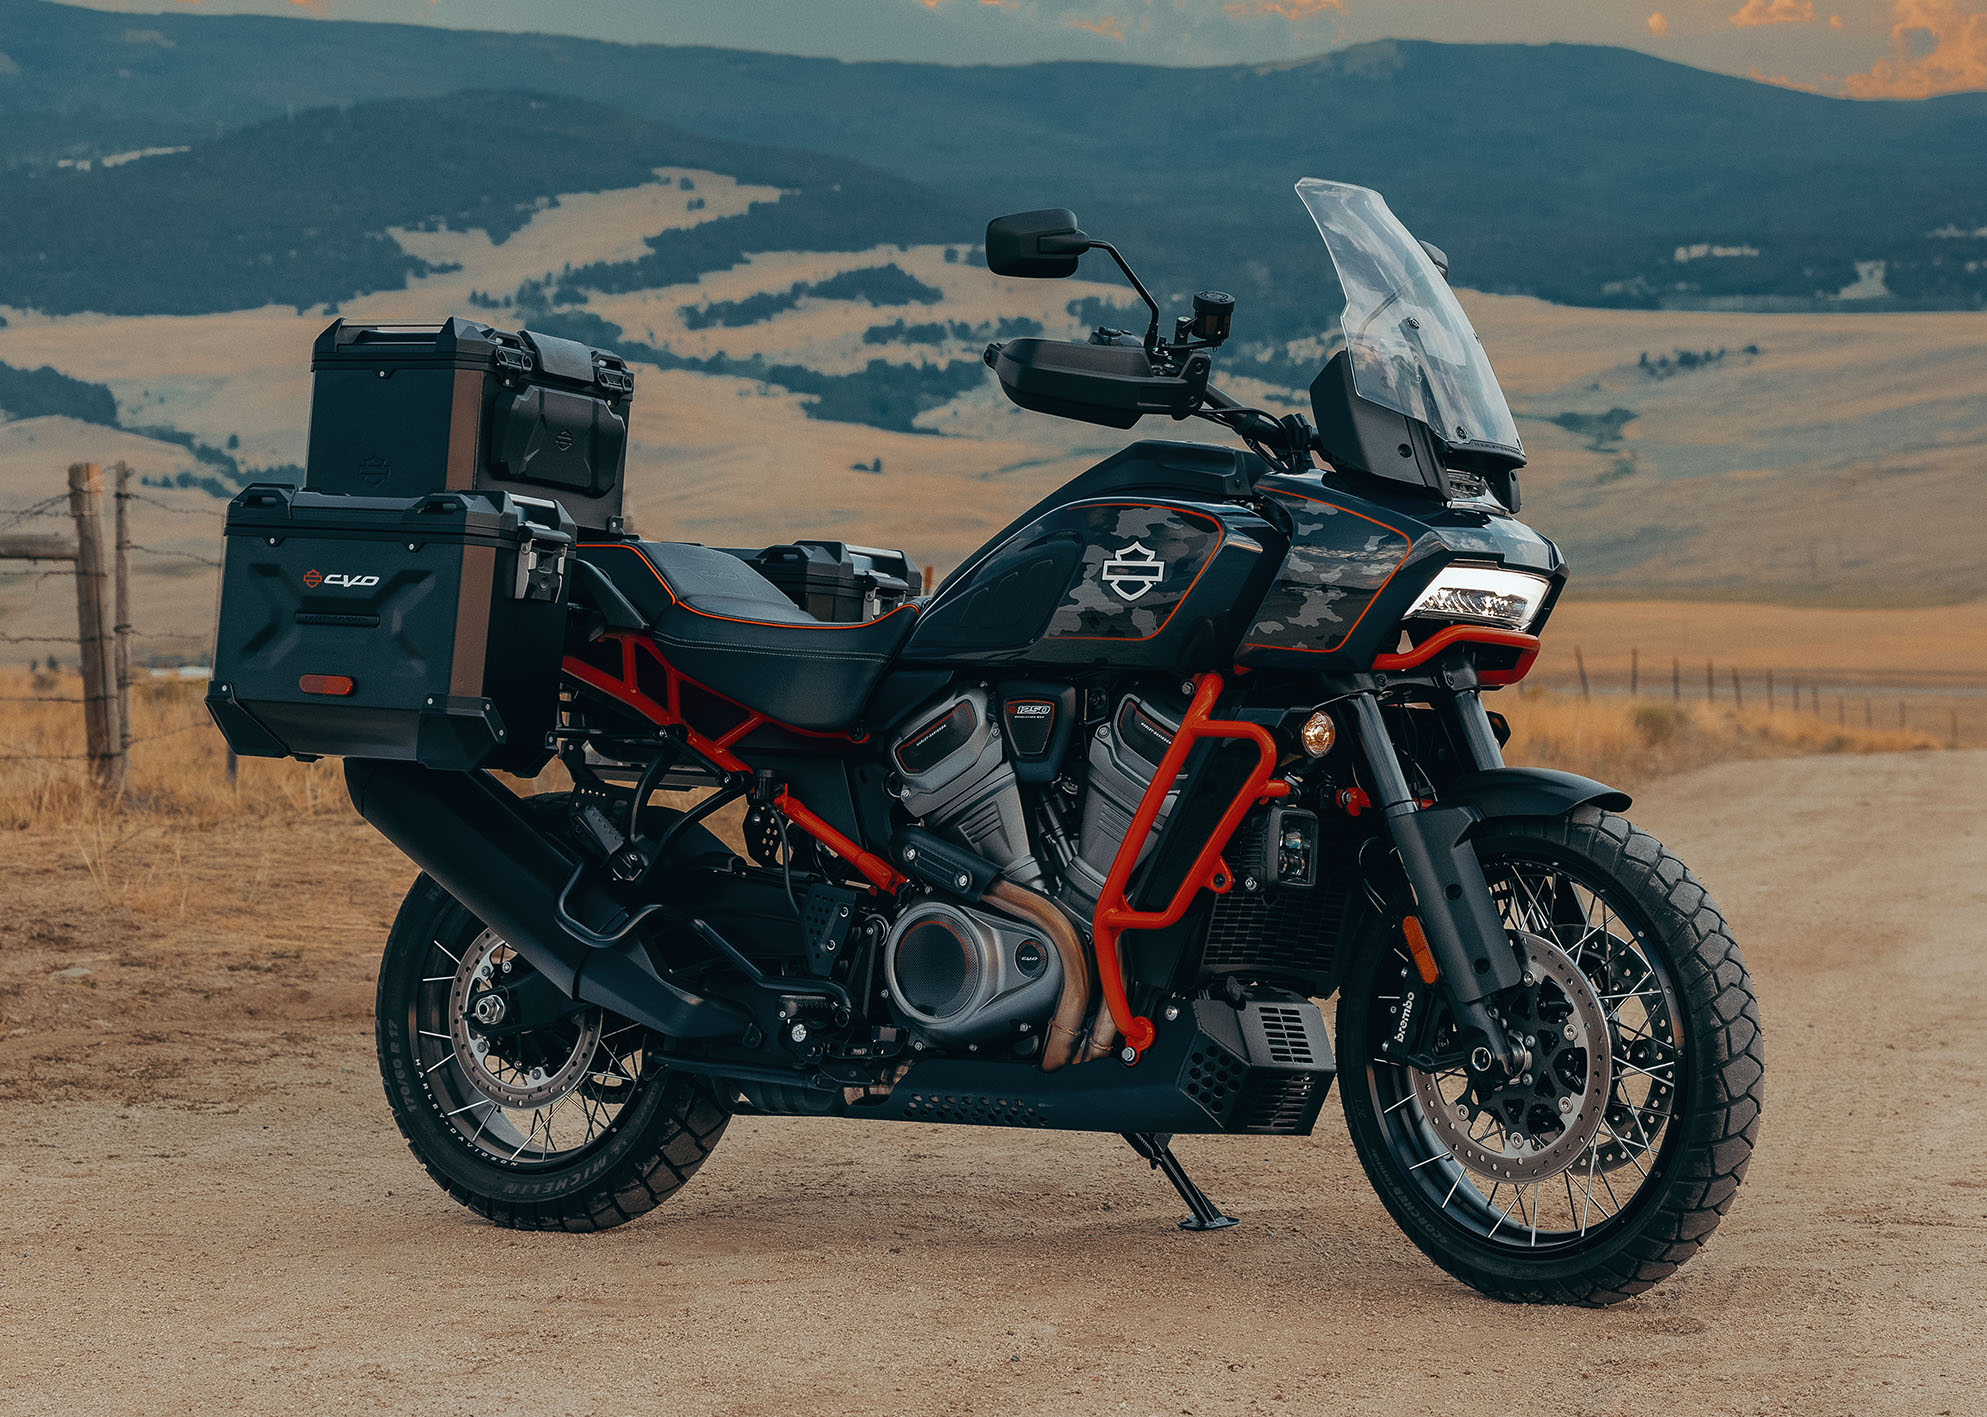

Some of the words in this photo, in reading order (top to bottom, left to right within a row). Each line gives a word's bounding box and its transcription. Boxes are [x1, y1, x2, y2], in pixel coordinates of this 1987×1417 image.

[323, 574, 380, 588] CVO
[1016, 705, 1051, 715] 1250
[1394, 991, 1415, 1043] brembo
[415, 1058, 519, 1167] HARLEY-DAVIDSON
[502, 1155, 608, 1196] MICHELIN
